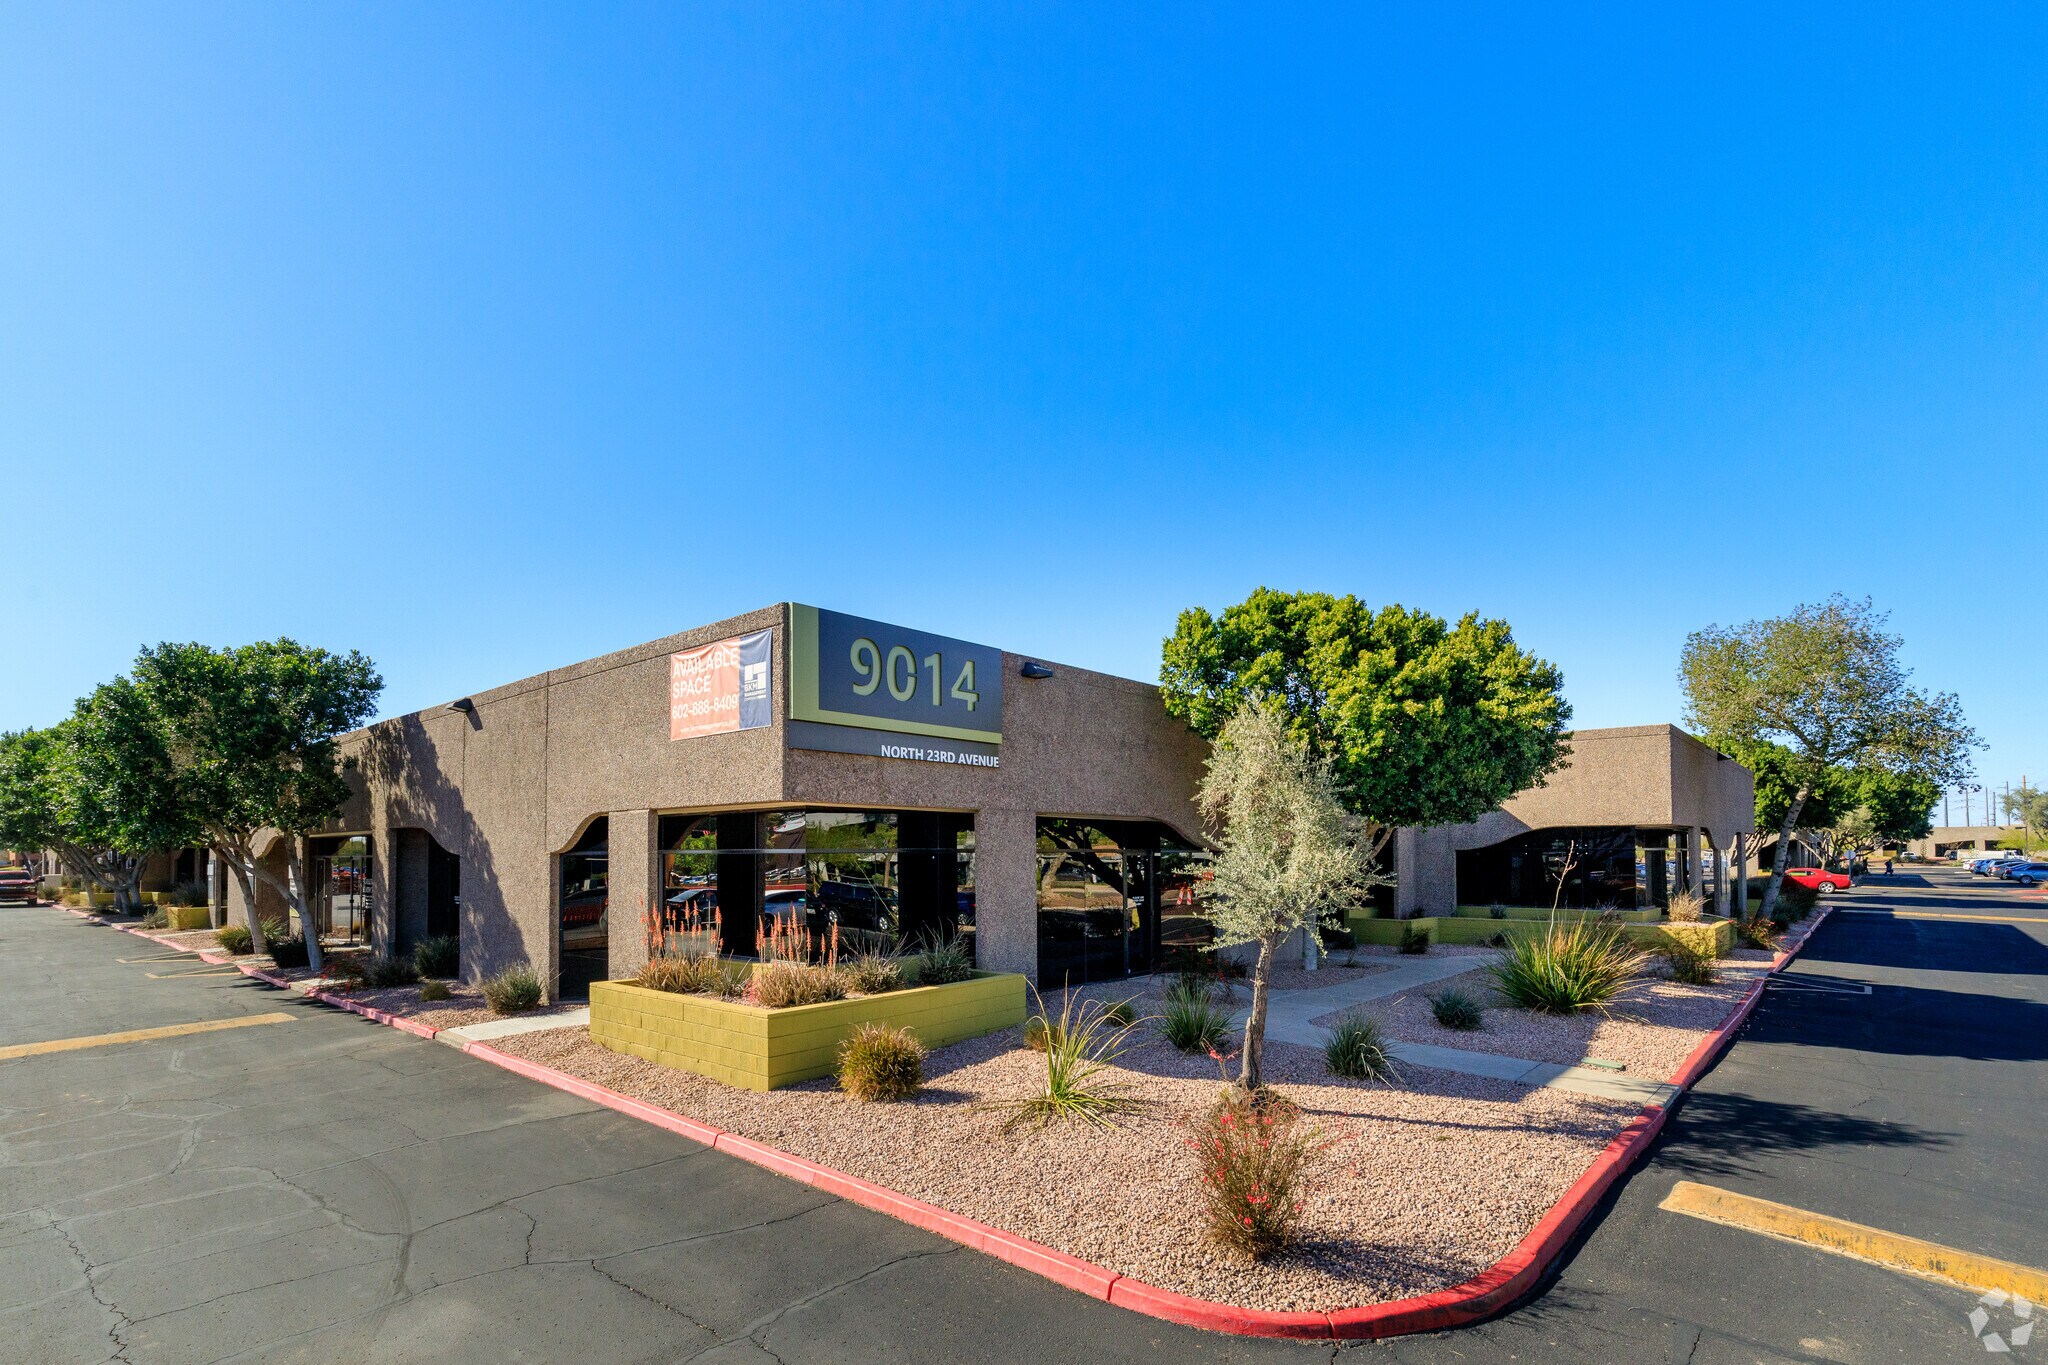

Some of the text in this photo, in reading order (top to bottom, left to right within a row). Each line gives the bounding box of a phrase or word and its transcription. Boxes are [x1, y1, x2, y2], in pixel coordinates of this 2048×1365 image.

[673, 648, 739, 678] AVAILABLE
[850, 638, 980, 712] 9014
[673, 675, 711, 699] SPACE
[672, 695, 738, 719] 602-688-6409
[881, 745, 1000, 768] NORTH 23RD AVENUE
